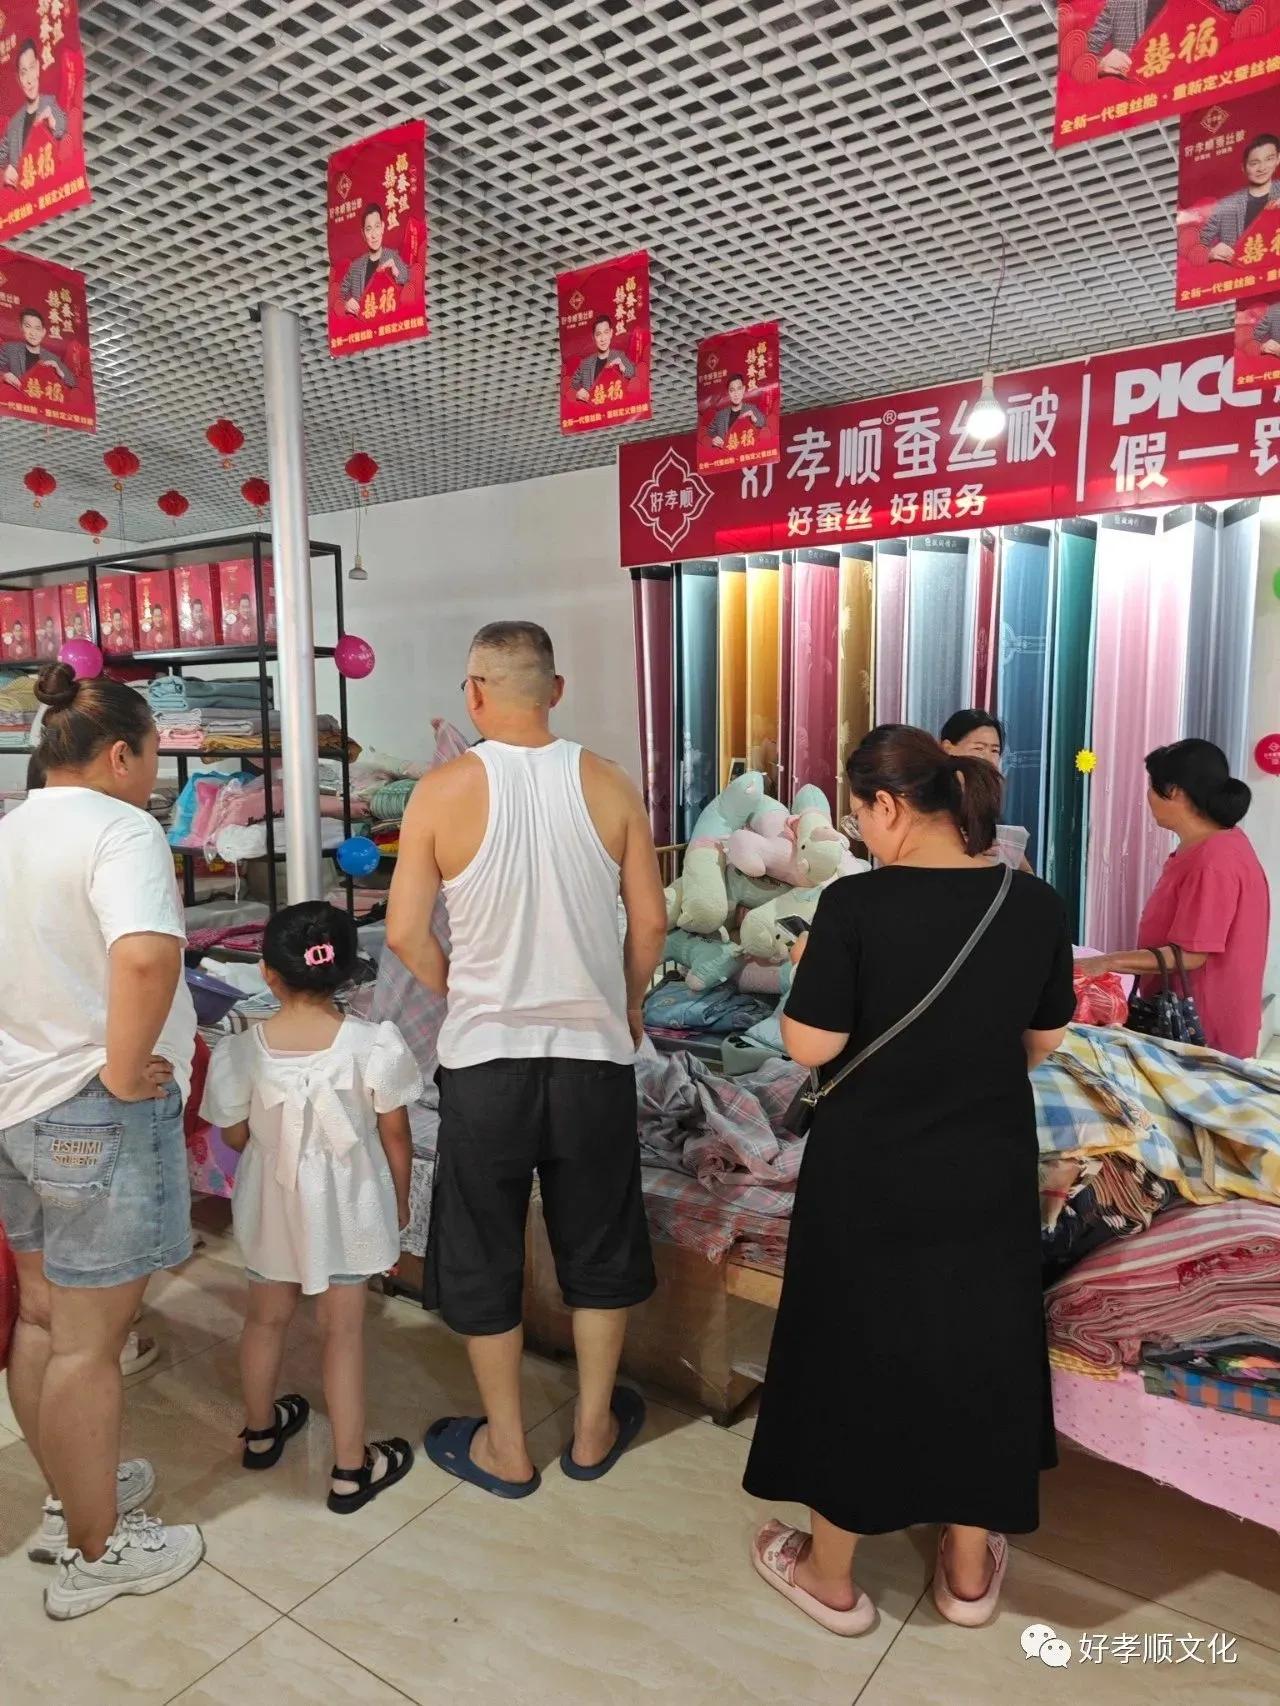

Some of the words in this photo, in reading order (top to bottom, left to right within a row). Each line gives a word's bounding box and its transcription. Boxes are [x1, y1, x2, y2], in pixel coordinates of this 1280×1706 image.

[1112, 355, 1262, 426] PICC
[650, 487, 693, 513] 好孝顺
[787, 498, 873, 537] 好蚕丝
[890, 484, 987, 525] 好服务
